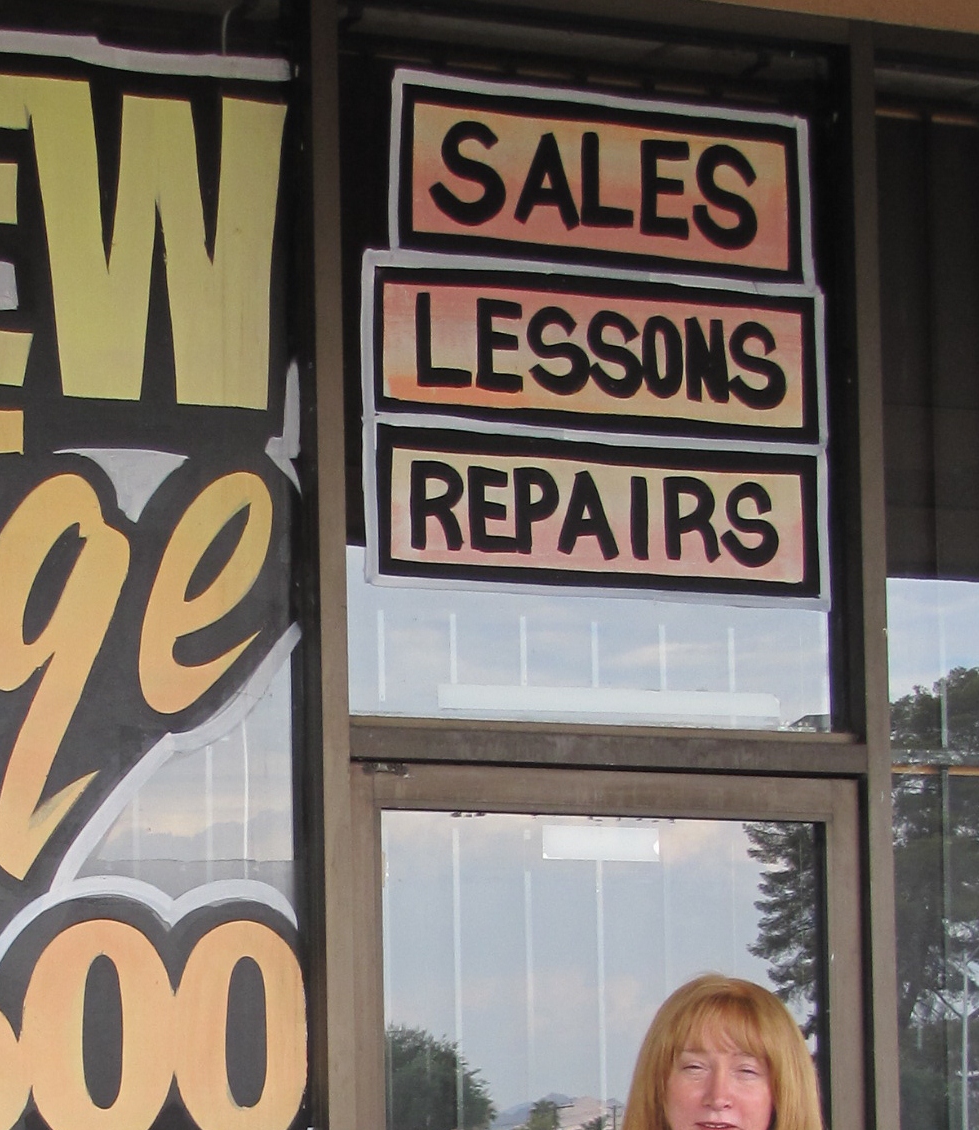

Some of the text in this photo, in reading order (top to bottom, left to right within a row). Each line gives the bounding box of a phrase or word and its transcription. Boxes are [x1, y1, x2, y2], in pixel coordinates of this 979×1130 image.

[428, 121, 757, 250] SALES
[415, 292, 787, 410] LESSONS
[410, 460, 779, 567] REPAIRS
